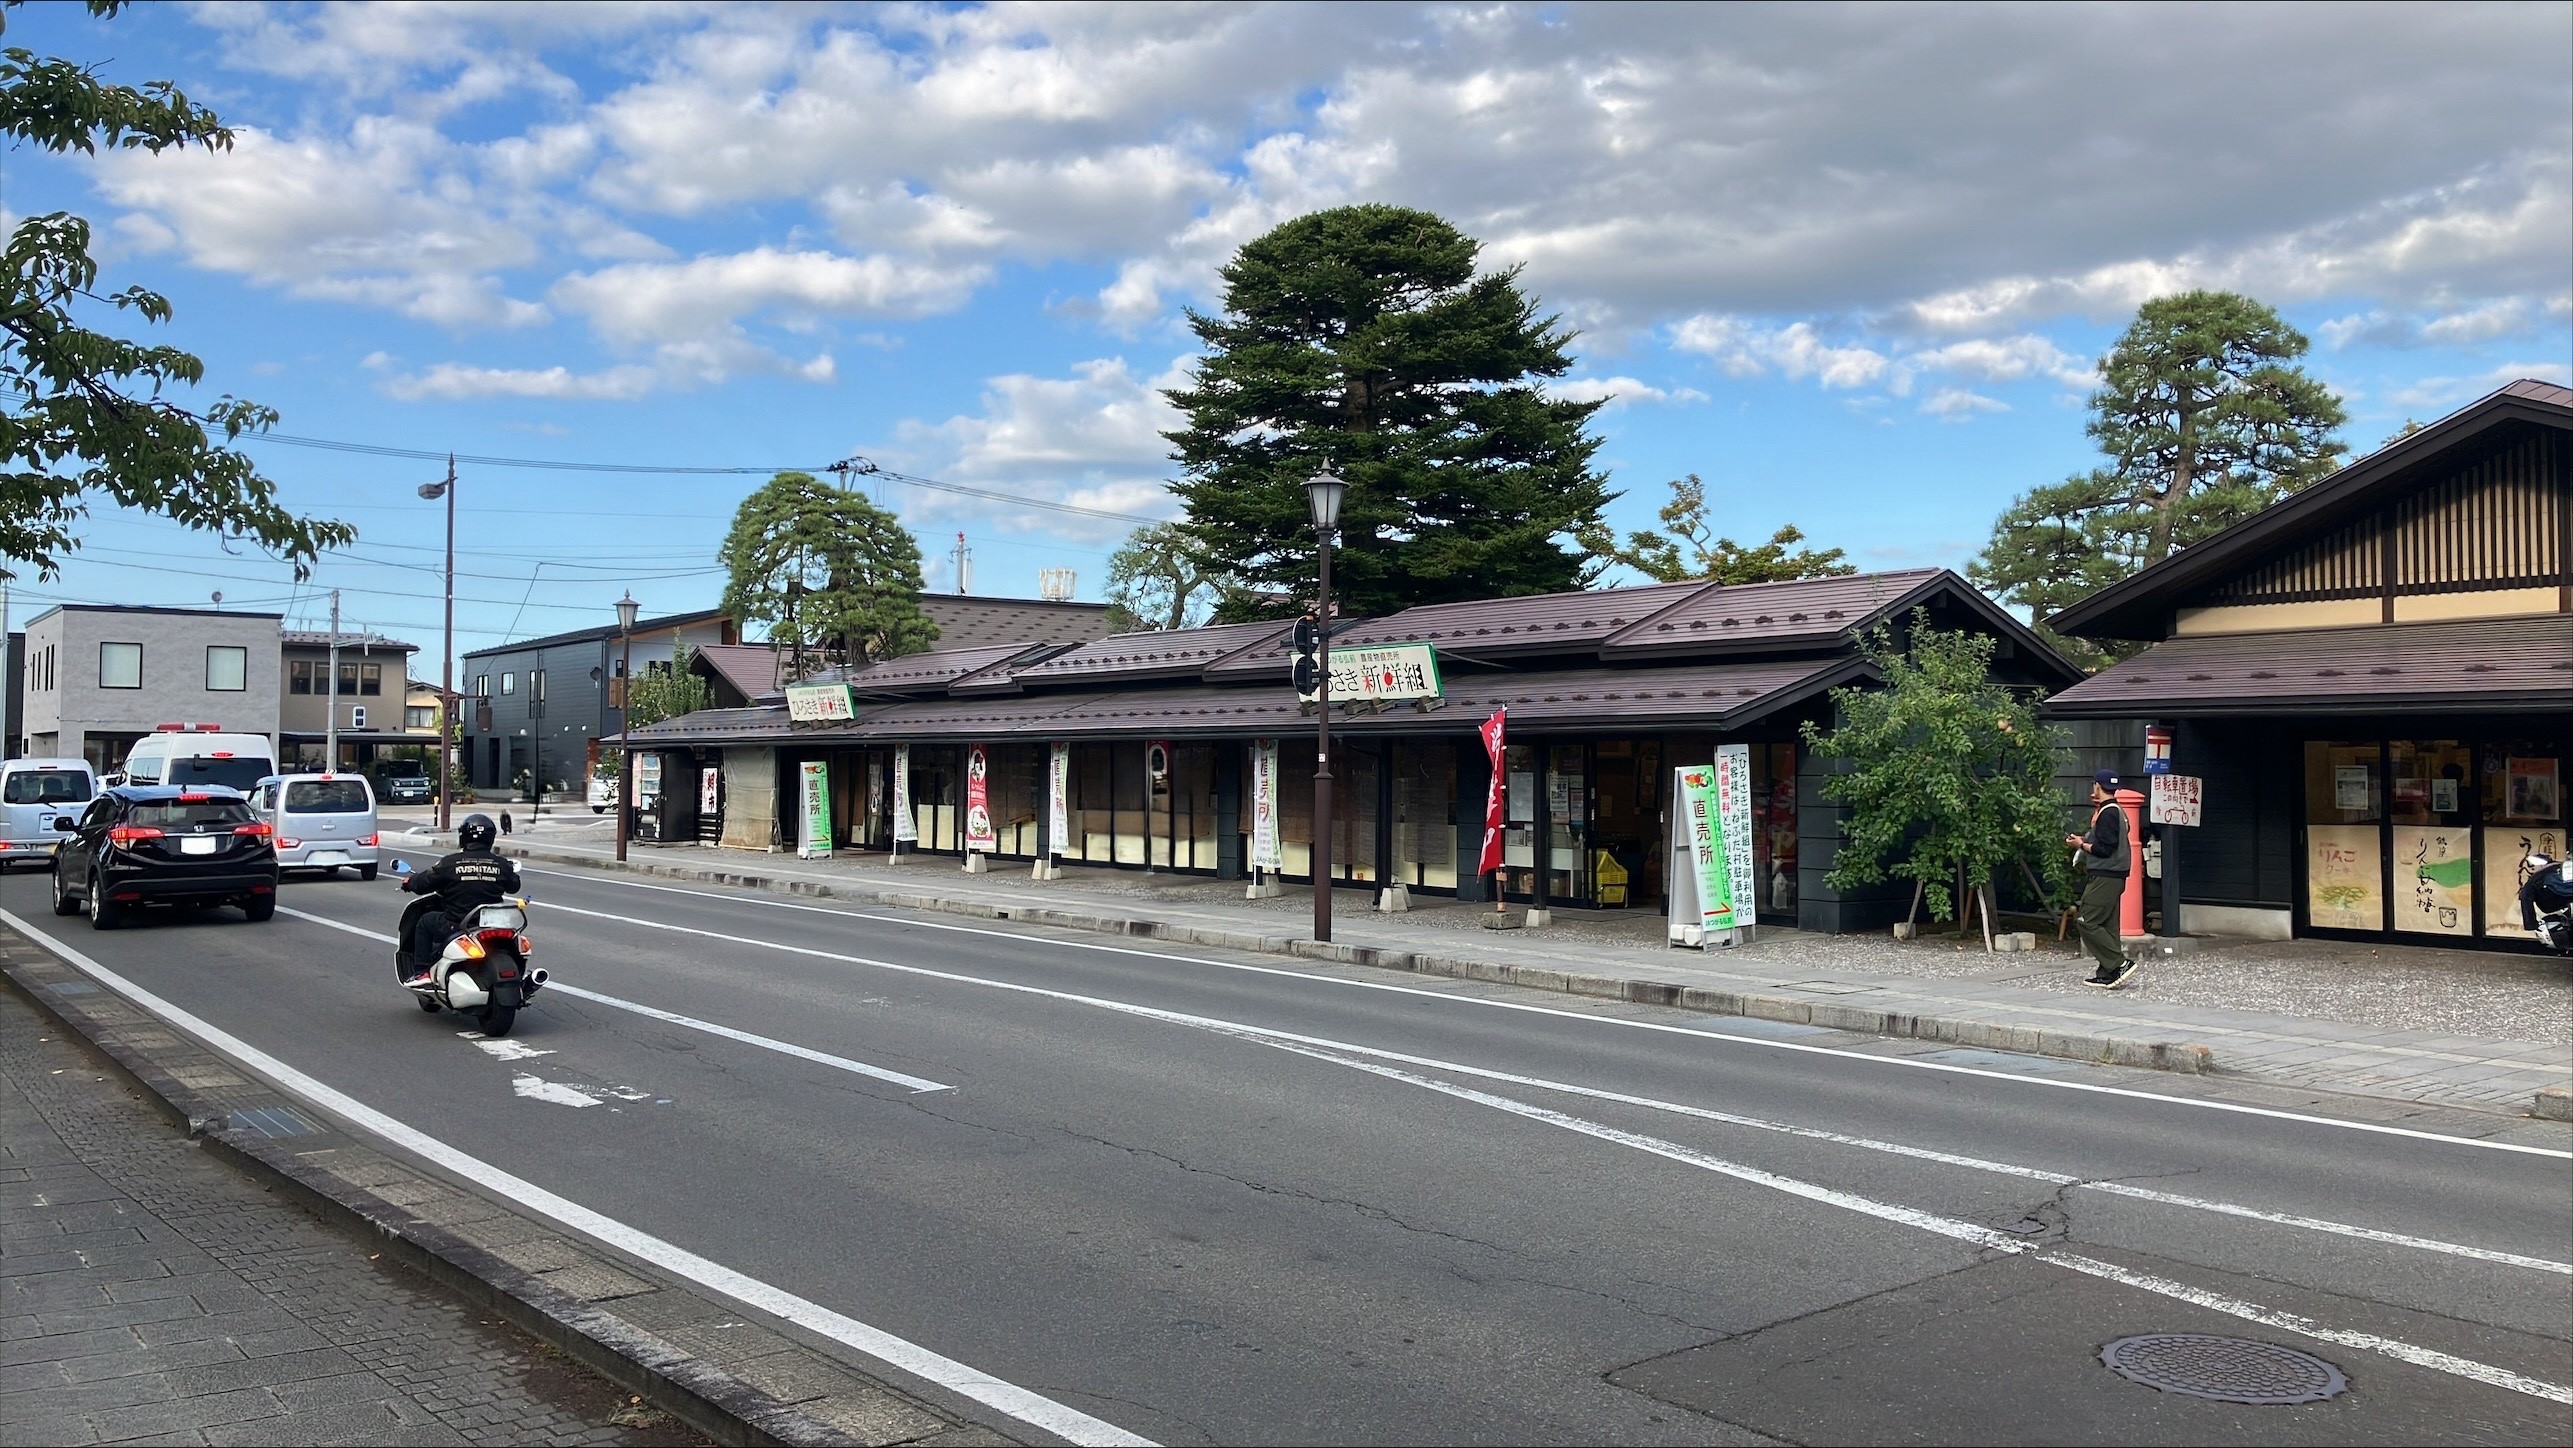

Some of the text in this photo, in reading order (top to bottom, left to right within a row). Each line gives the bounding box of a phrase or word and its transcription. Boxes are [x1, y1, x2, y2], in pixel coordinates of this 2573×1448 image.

[809, 779, 821, 815] 直売所
[1693, 799, 1713, 865] 直売所
[456, 865, 500, 875] KUSHITANI
